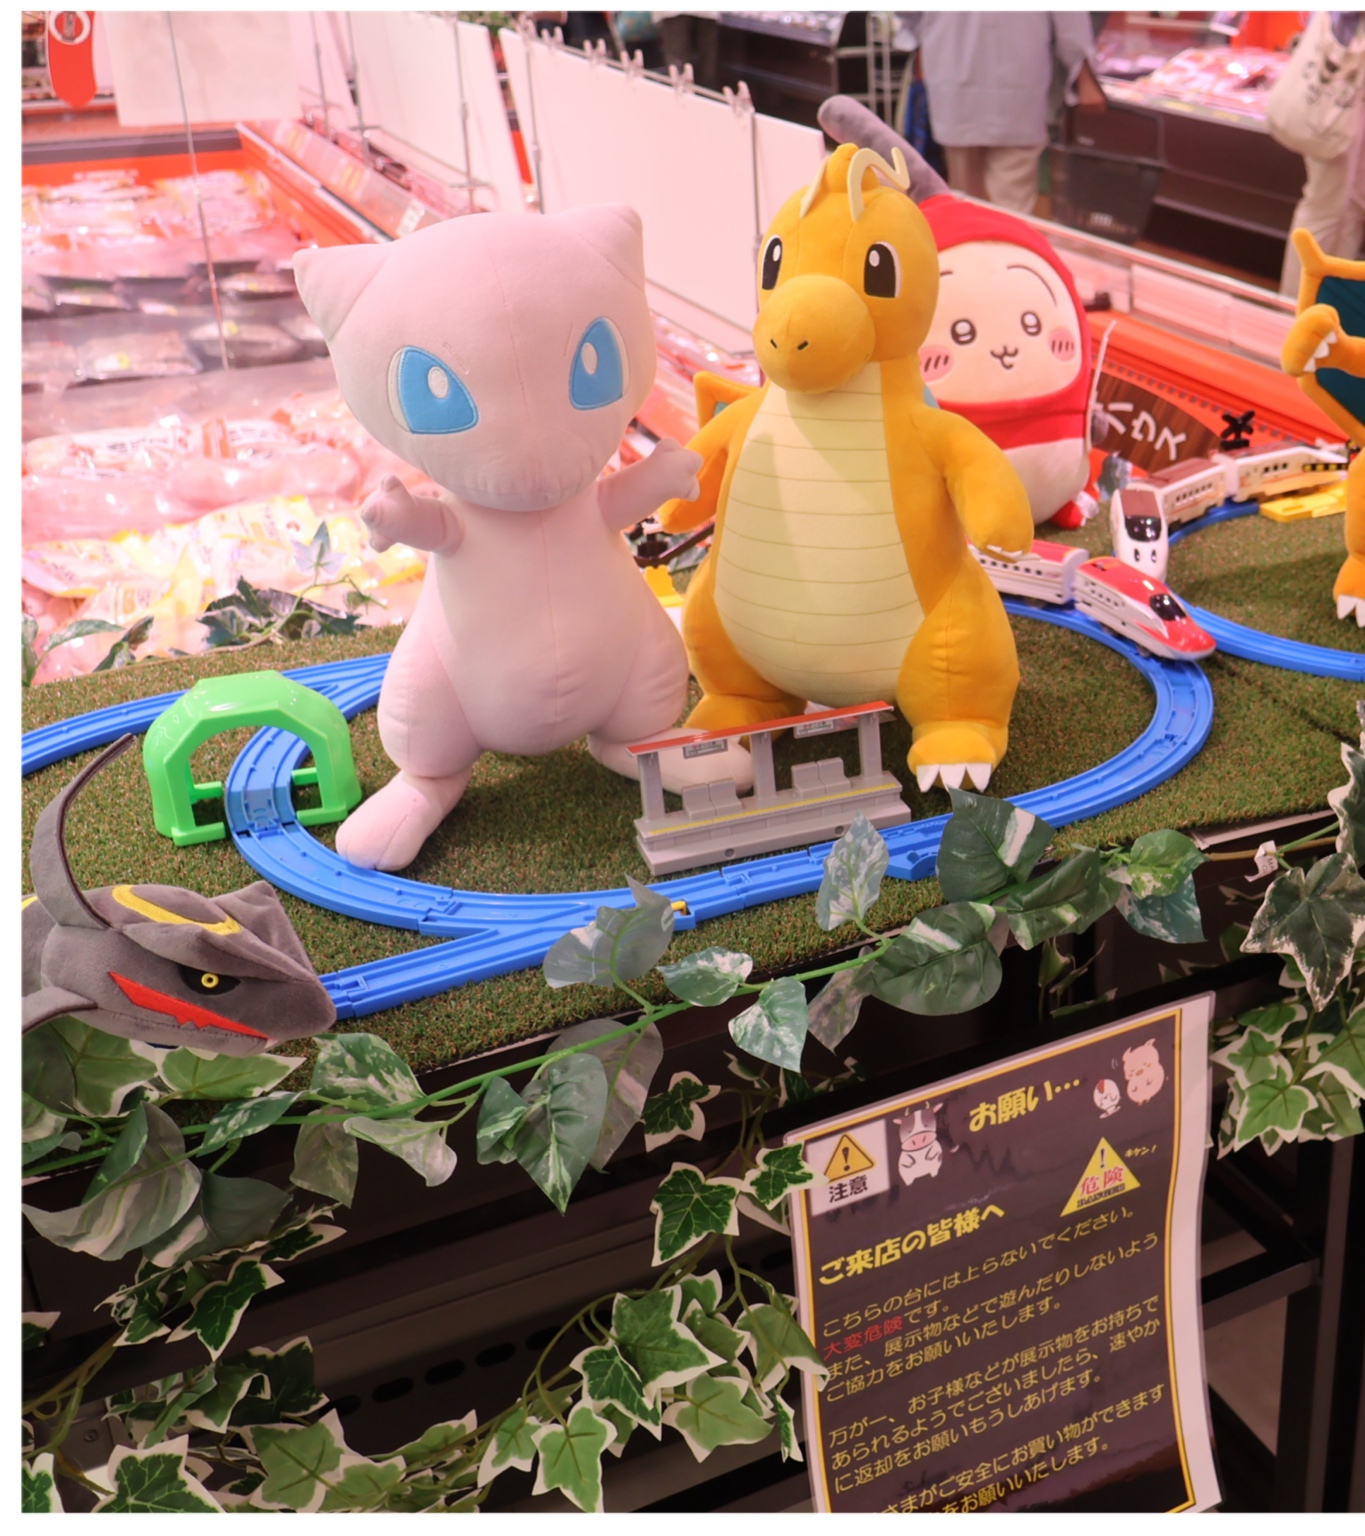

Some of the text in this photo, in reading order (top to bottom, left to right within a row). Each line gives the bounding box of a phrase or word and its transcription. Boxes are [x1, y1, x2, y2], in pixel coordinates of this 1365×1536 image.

[828, 1173, 870, 1205] 注意
[1079, 1165, 1125, 1197] 危険
[818, 1202, 1006, 1287] ご来店の皆様へ
[822, 1207, 1135, 1338] こちらの台には上らないでください。
[822, 1302, 952, 1362] 大変危険です。
[826, 1296, 1063, 1403] ご協力をお願いいたします。
[834, 1368, 1103, 1495] に返却をお願いもうしあげます。
